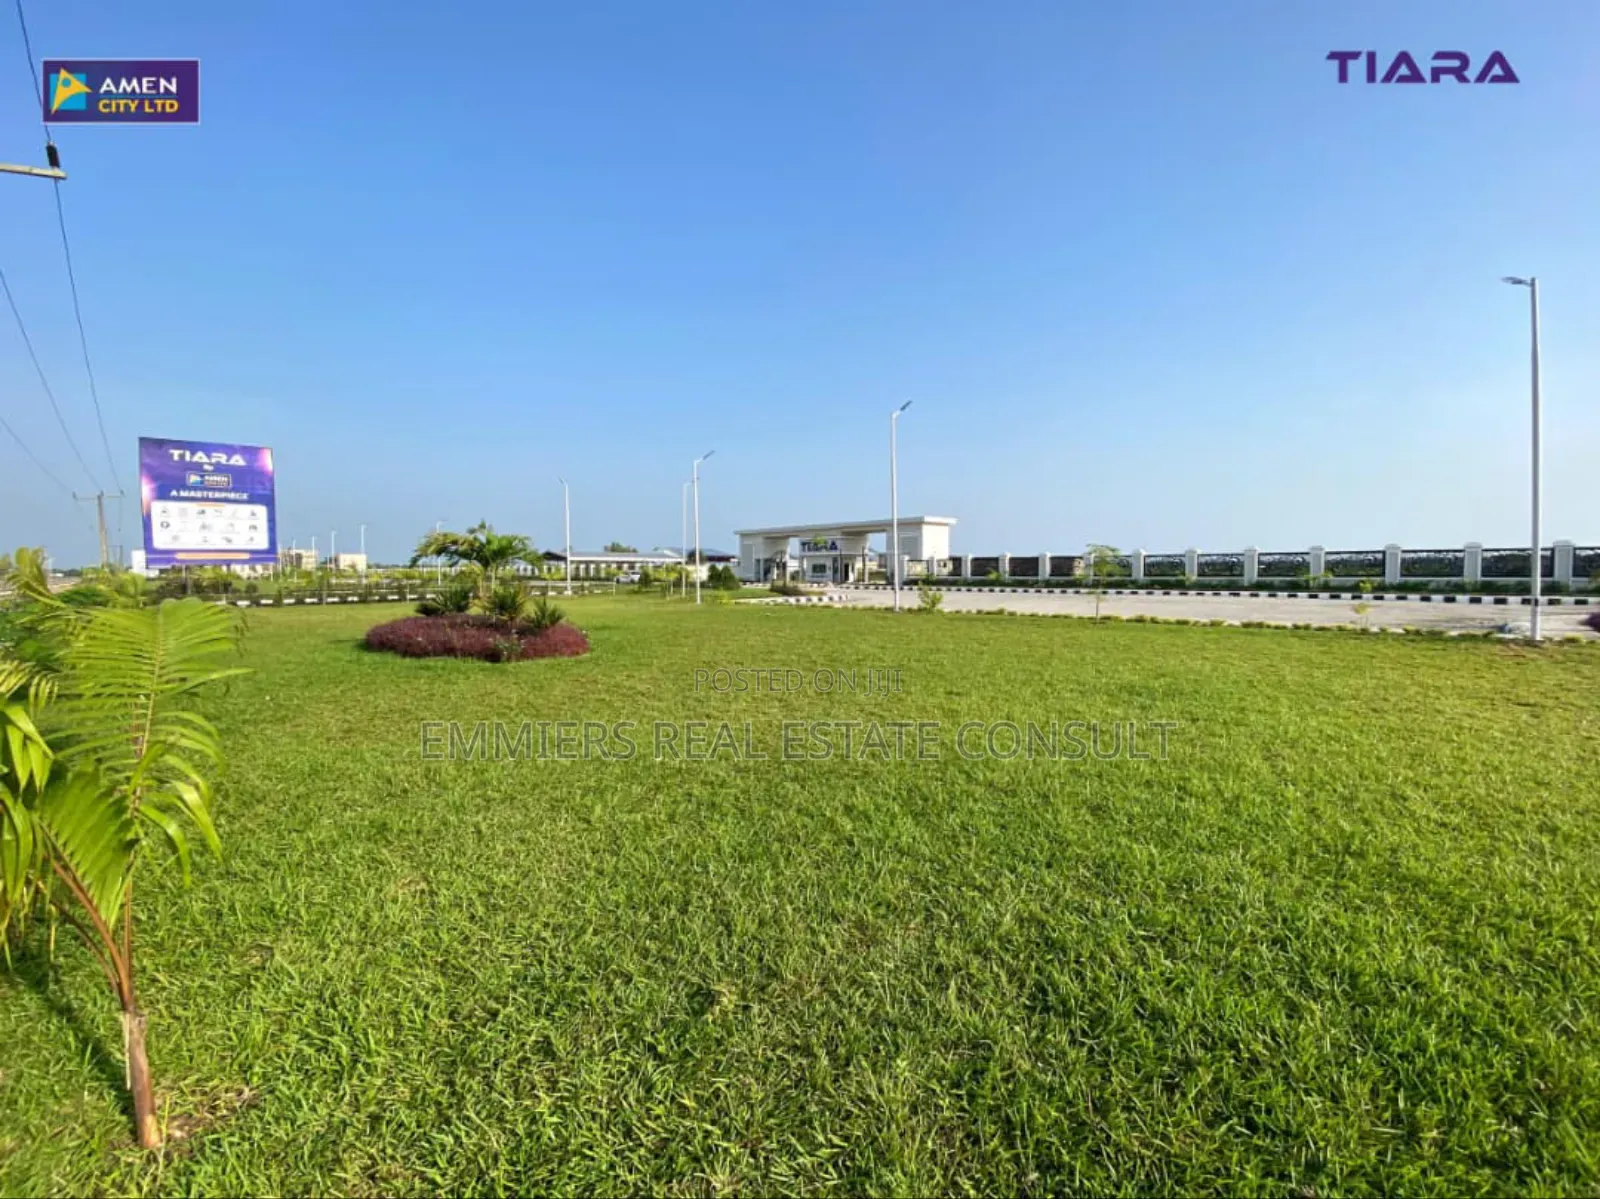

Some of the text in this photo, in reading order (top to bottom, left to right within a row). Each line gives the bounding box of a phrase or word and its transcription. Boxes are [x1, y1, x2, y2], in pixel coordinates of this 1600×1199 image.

[169, 449, 247, 466] TIARA
[170, 489, 249, 500] A MASTERPIECE
